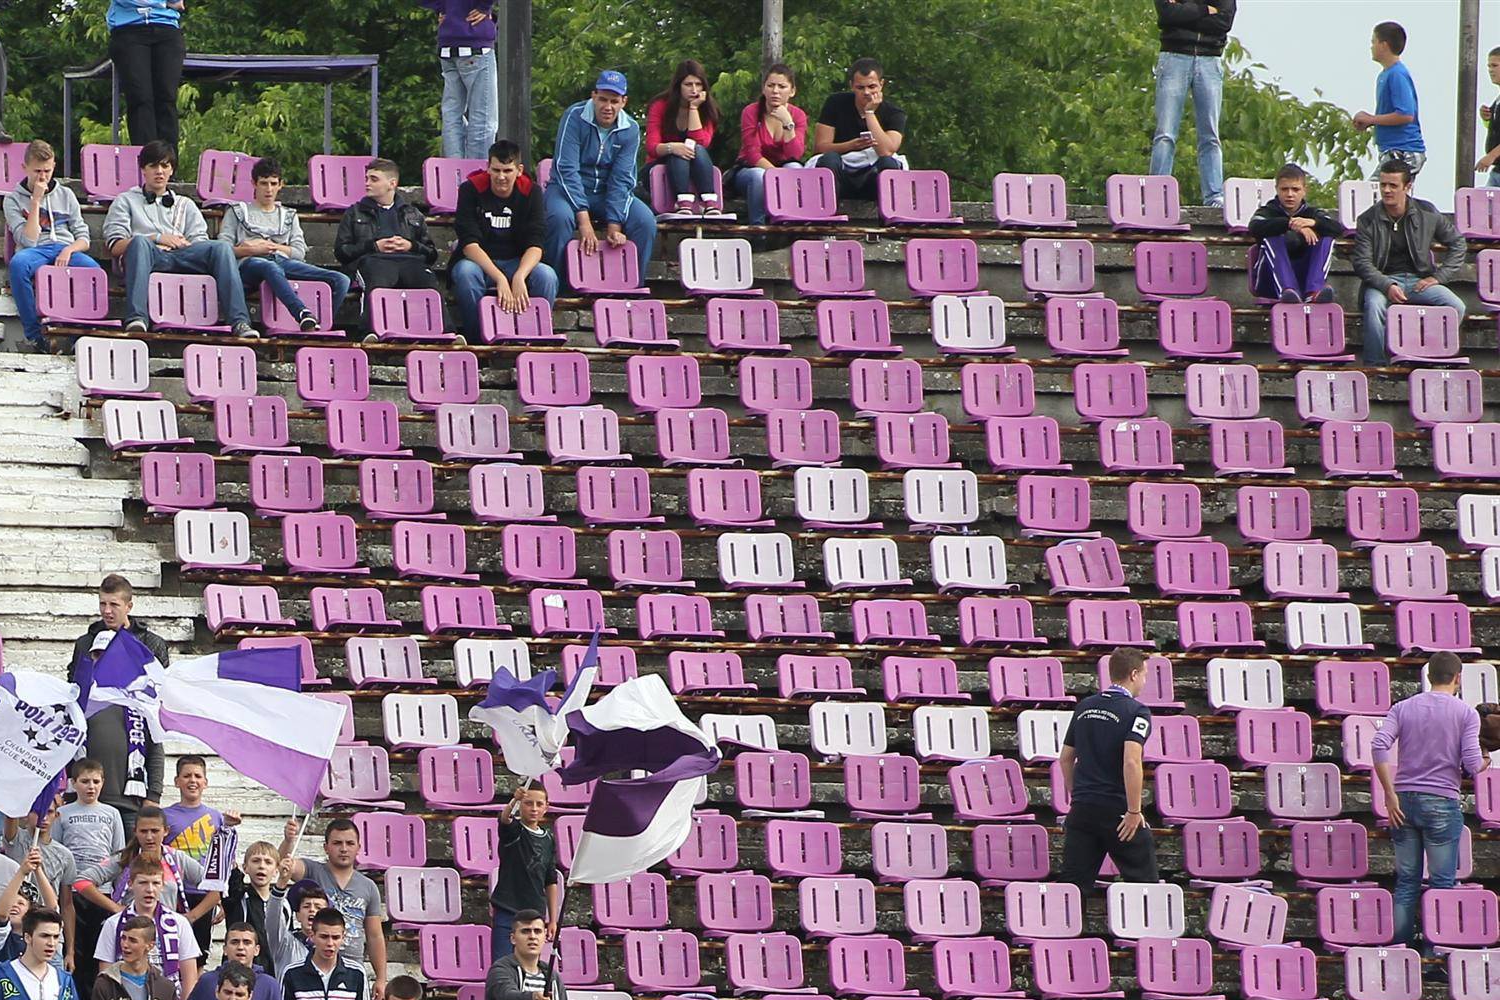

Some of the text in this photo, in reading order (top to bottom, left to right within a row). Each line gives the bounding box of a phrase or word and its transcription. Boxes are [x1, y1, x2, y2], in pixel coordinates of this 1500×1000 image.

[14, 700, 85, 746] POLI 1921
[4, 739, 48, 769] CHAMPIONS
